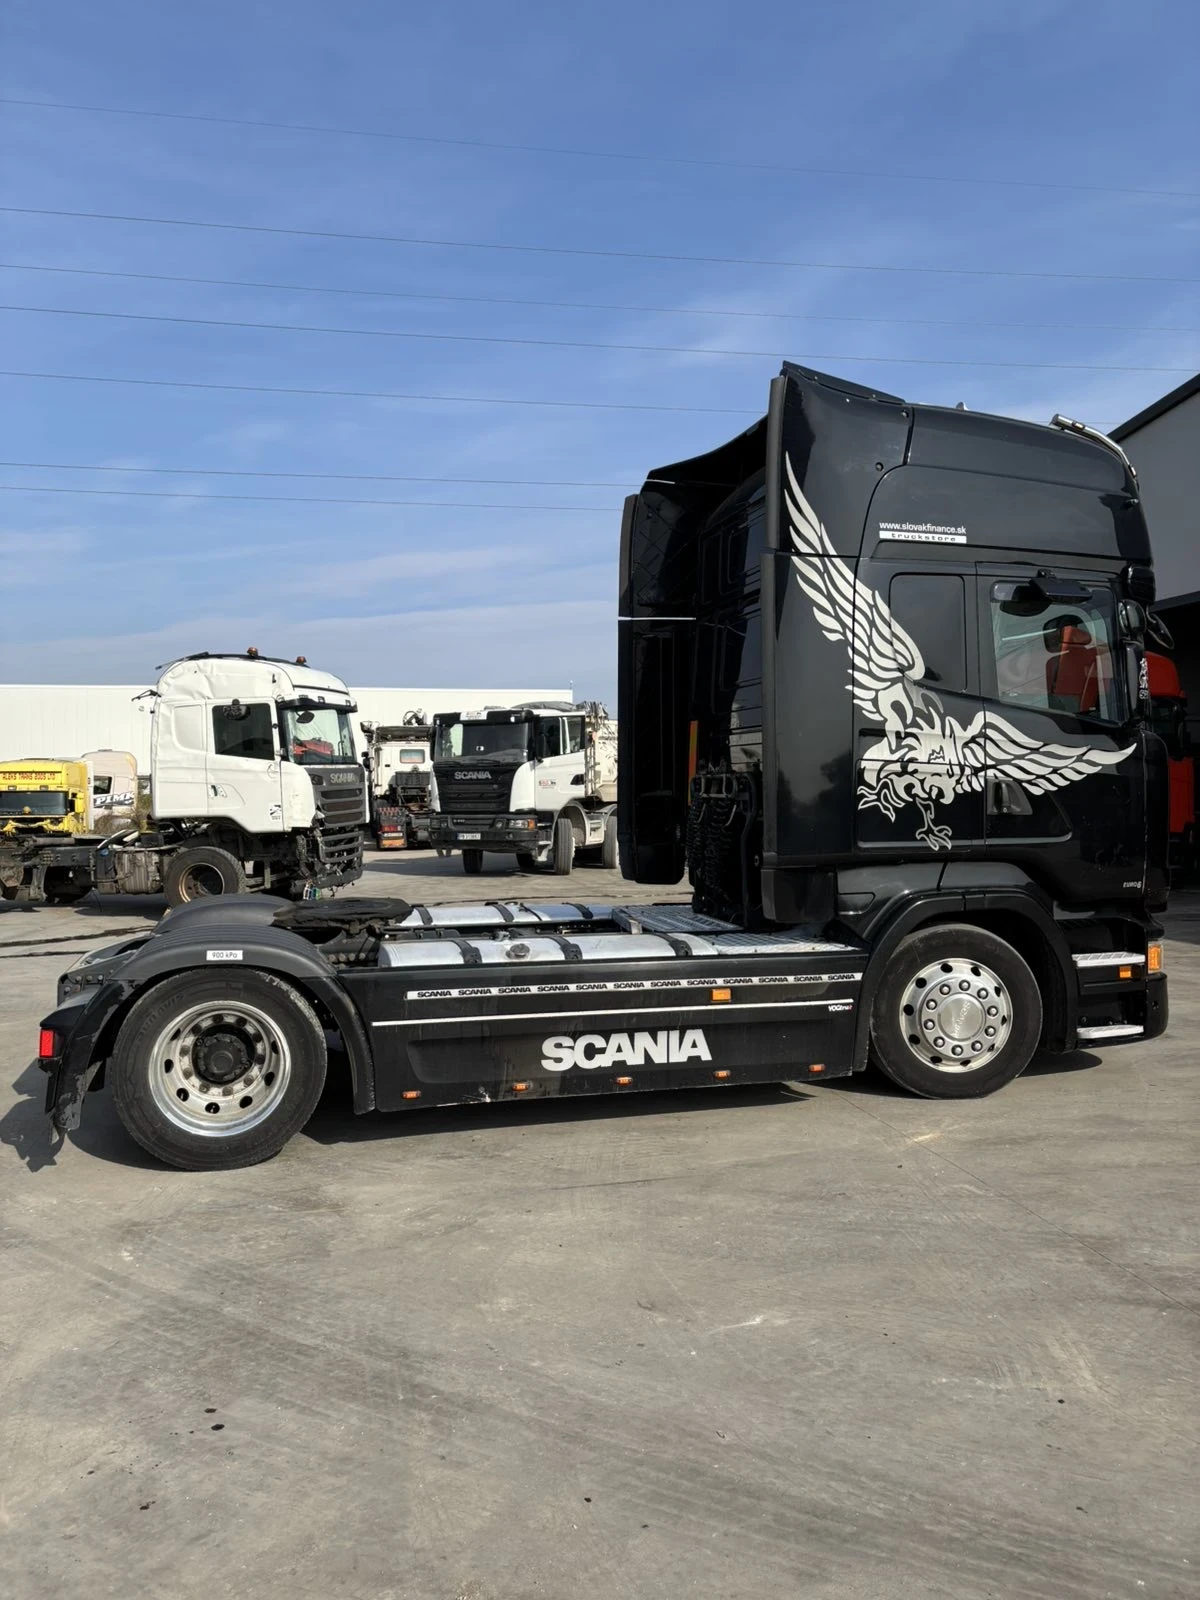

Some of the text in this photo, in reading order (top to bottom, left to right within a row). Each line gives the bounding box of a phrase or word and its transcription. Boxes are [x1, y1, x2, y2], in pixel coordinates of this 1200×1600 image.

[879, 522, 966, 534] www.slovakfinance.sk
[891, 533, 956, 542] truckstore
[454, 771, 492, 780] SCANIA
[95, 791, 135, 805] PIMK
[417, 973, 856, 998] SCANIA SCANIA SCANIA SCANIA SCANIA SCANIA SCANIA SCANIA SCANIA SCANIA SCANIA SCANIA
[540, 1028, 712, 1072] SCANIA
